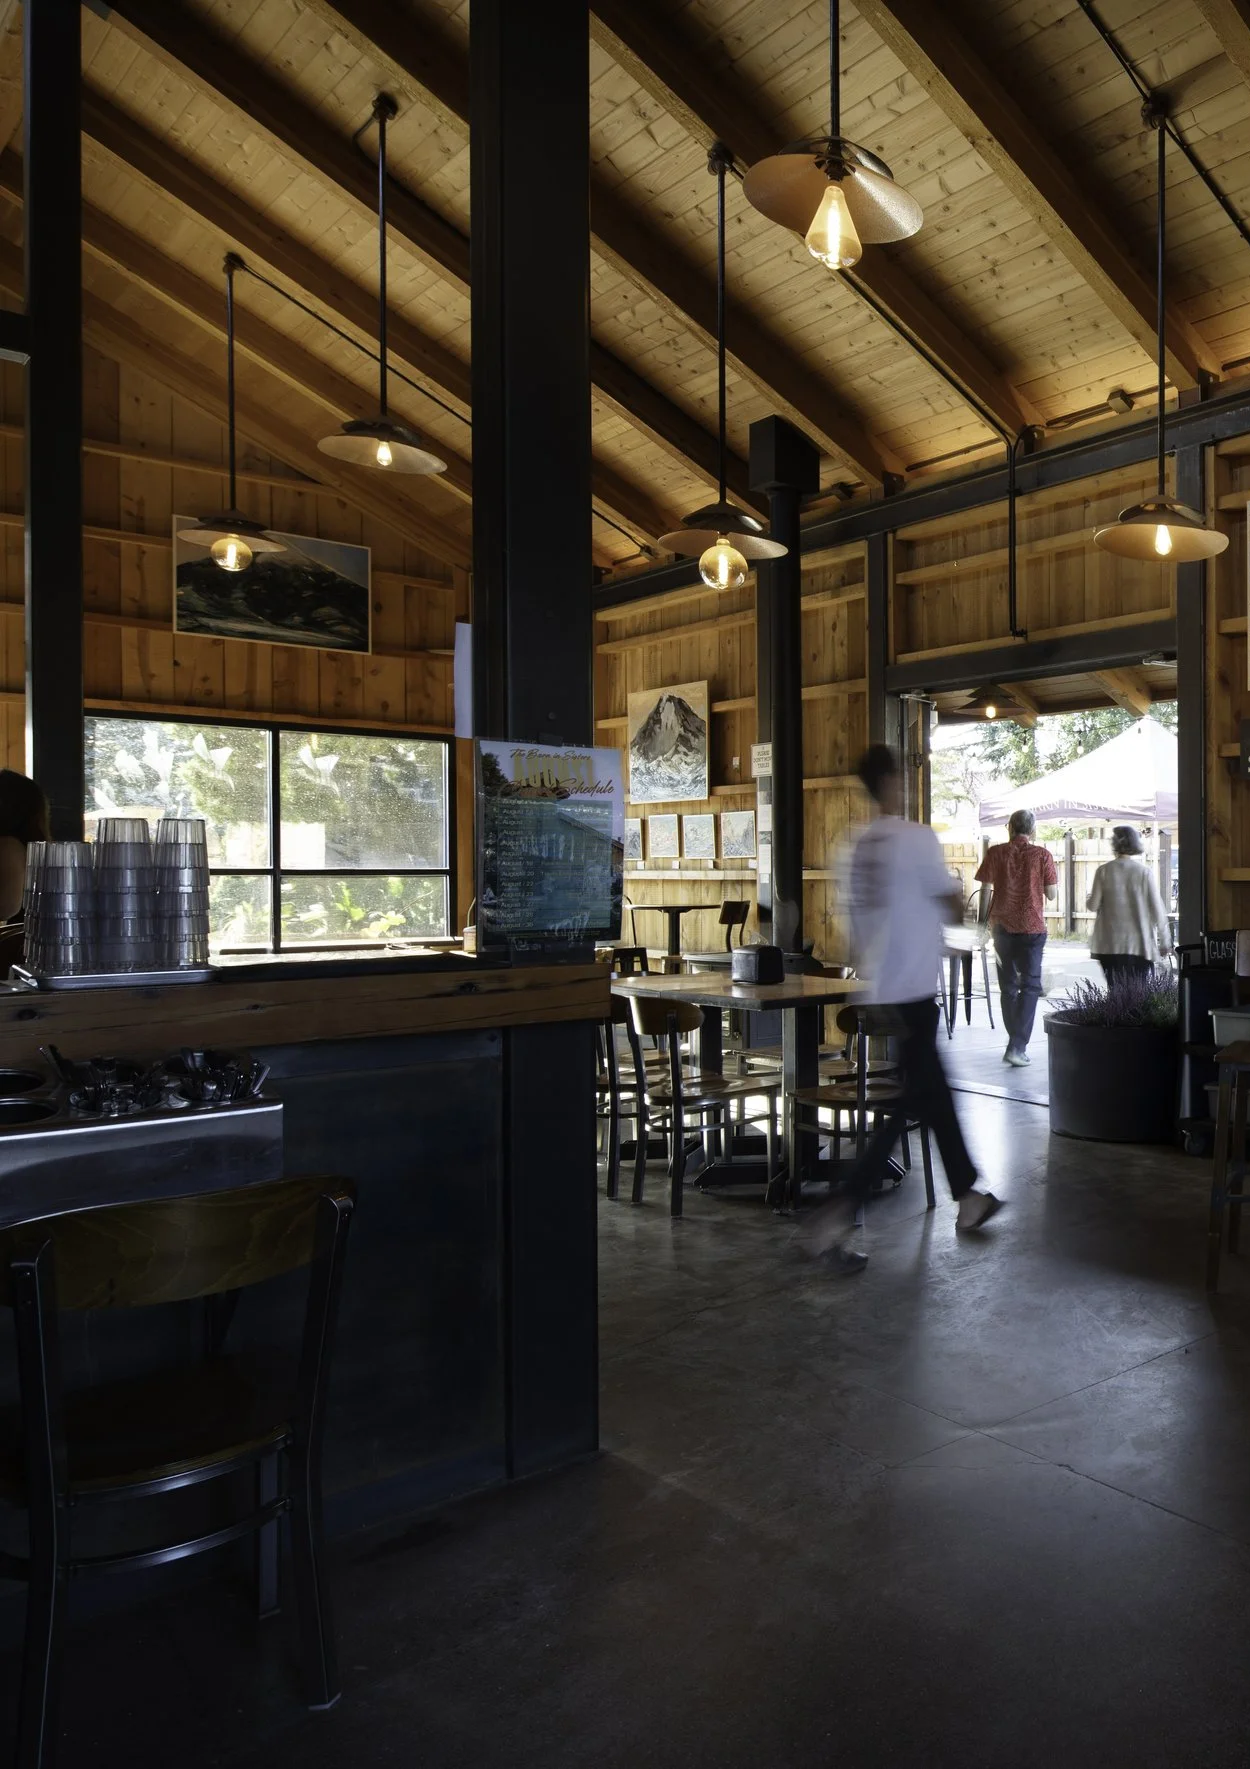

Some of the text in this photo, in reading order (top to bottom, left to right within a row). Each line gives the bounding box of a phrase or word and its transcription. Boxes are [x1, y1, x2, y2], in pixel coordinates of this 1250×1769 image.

[526, 749, 550, 760] Barn
[553, 751, 561, 759] in
[512, 757, 595, 787] AUGUST
[557, 778, 615, 797] Schedule
